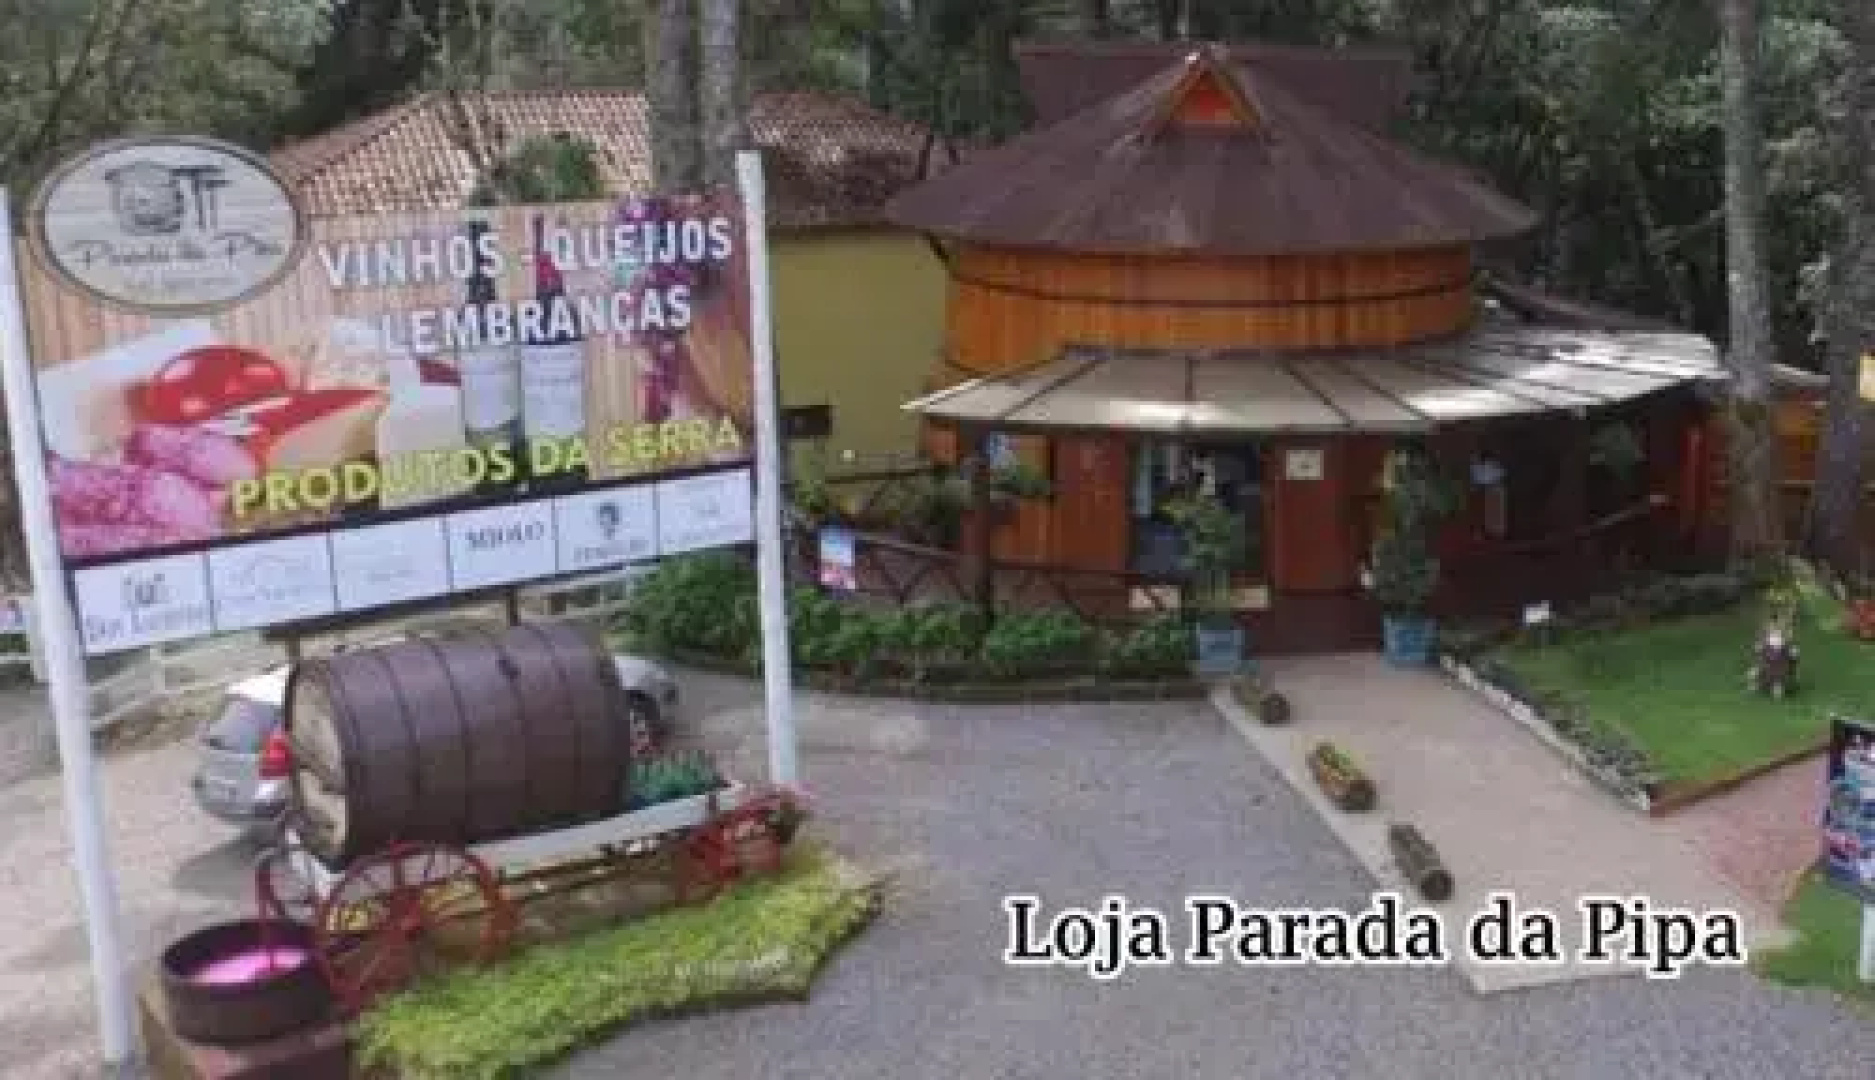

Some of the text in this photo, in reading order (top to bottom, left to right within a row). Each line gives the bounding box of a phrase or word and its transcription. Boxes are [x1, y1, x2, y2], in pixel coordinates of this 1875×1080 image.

[318, 232, 504, 288] VINHOS
[542, 216, 734, 271] QUEIJOS
[231, 414, 743, 518] PRODUTOS DA SERRA
